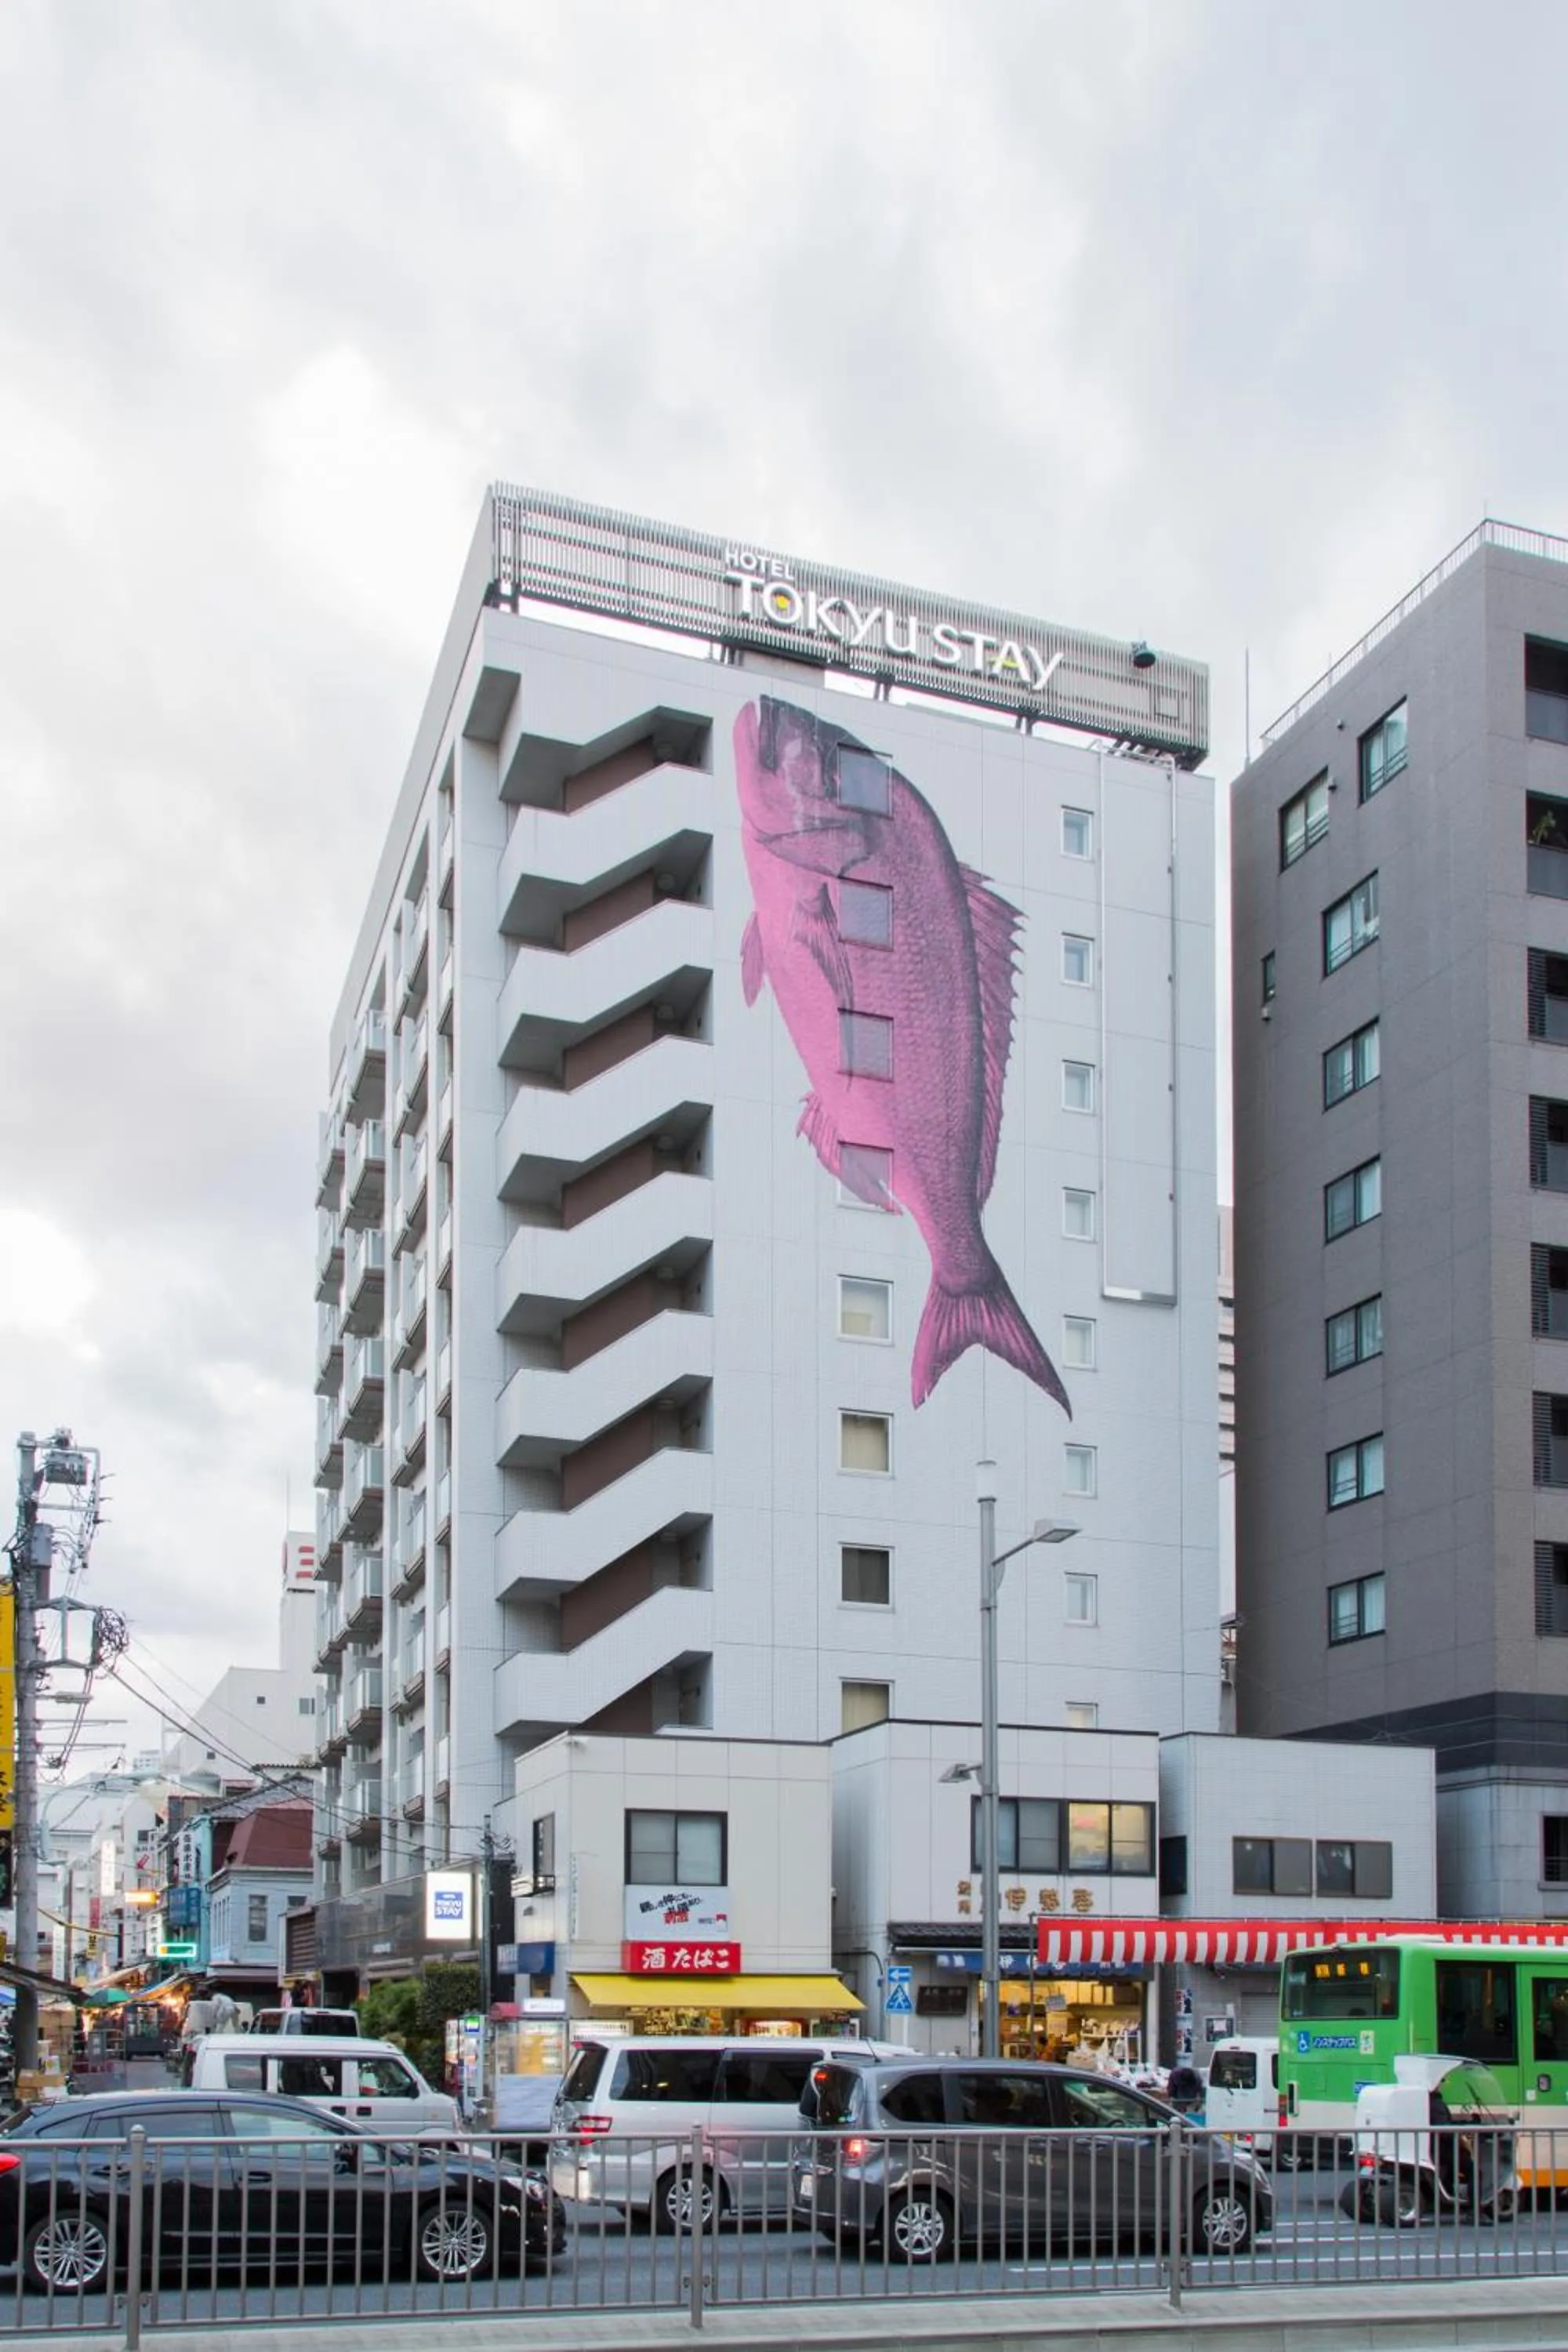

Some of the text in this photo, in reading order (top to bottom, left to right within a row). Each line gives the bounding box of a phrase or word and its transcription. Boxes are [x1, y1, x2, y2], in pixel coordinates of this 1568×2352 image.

[724, 549, 795, 582] HOTEL
[724, 570, 1064, 691] TOKYU STAY
[642, 1947, 729, 1969] 酒 たばこ
